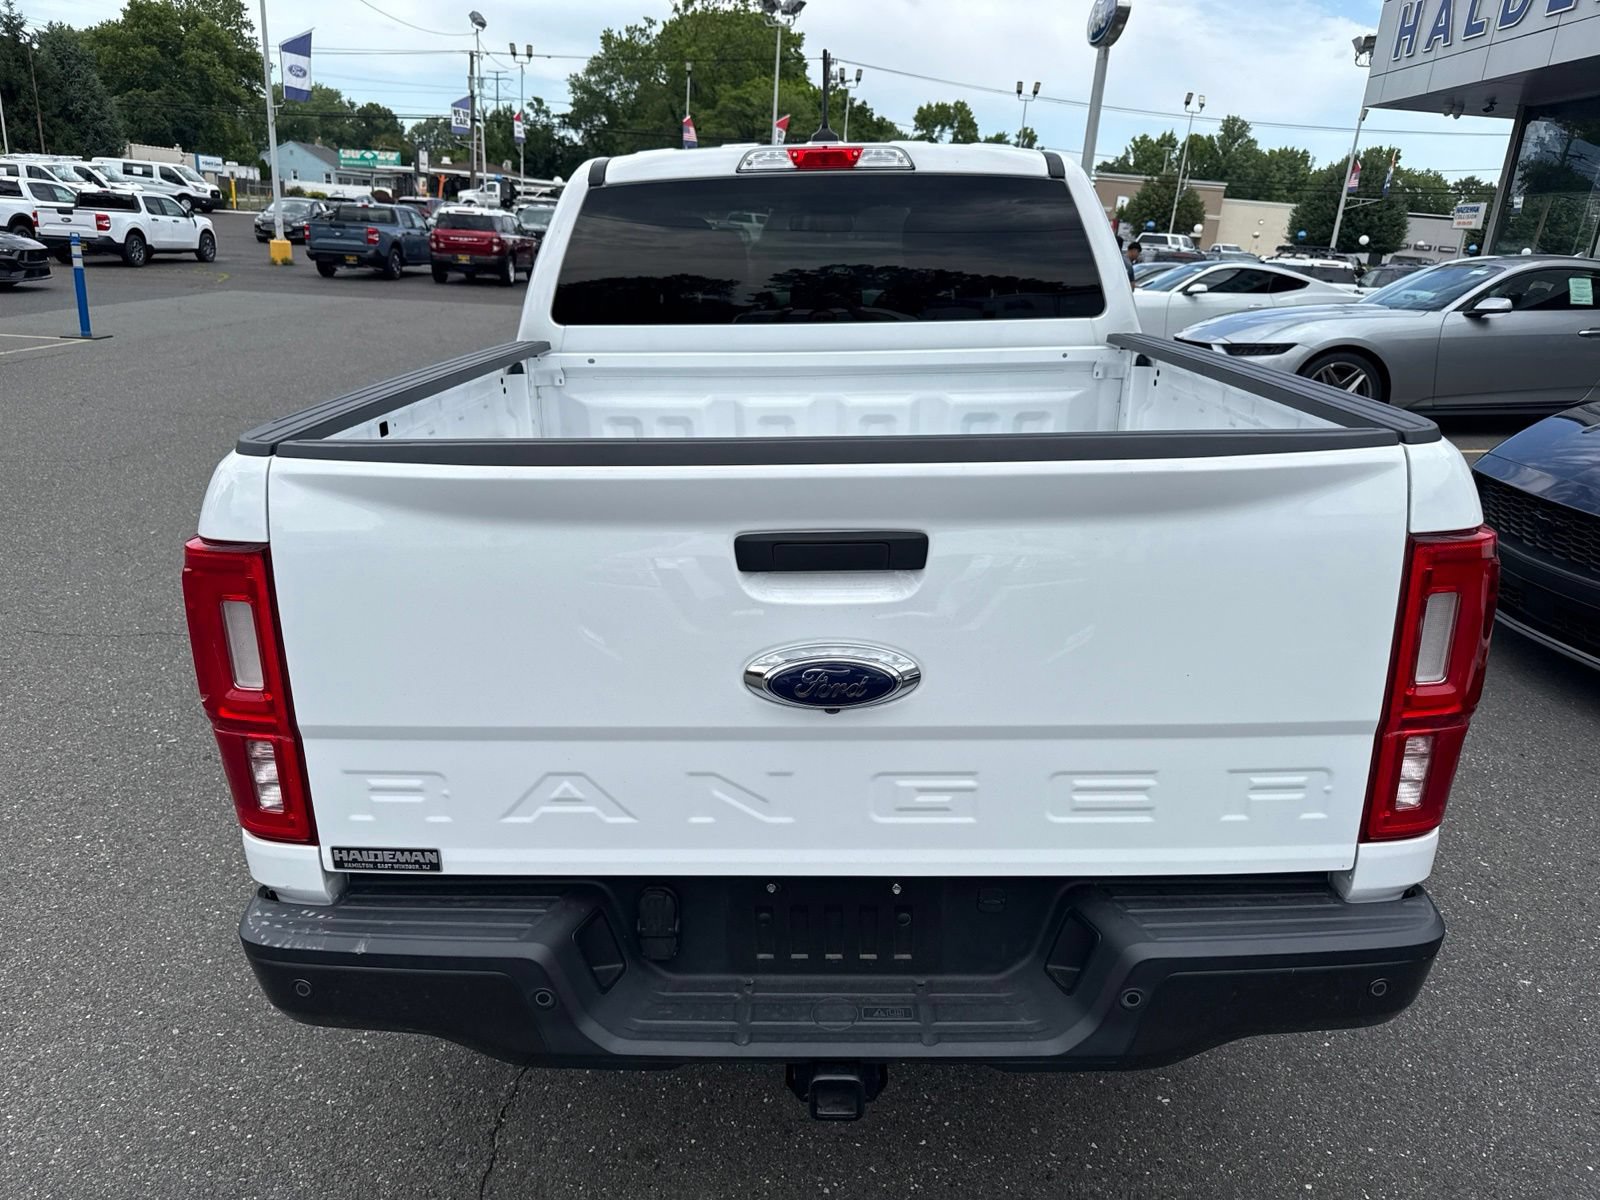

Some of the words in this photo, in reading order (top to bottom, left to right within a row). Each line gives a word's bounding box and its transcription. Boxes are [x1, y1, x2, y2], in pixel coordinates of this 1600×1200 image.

[794, 668, 869, 698] Ford
[341, 767, 1334, 825] RANGER
[333, 850, 438, 863] HALDEMAN
